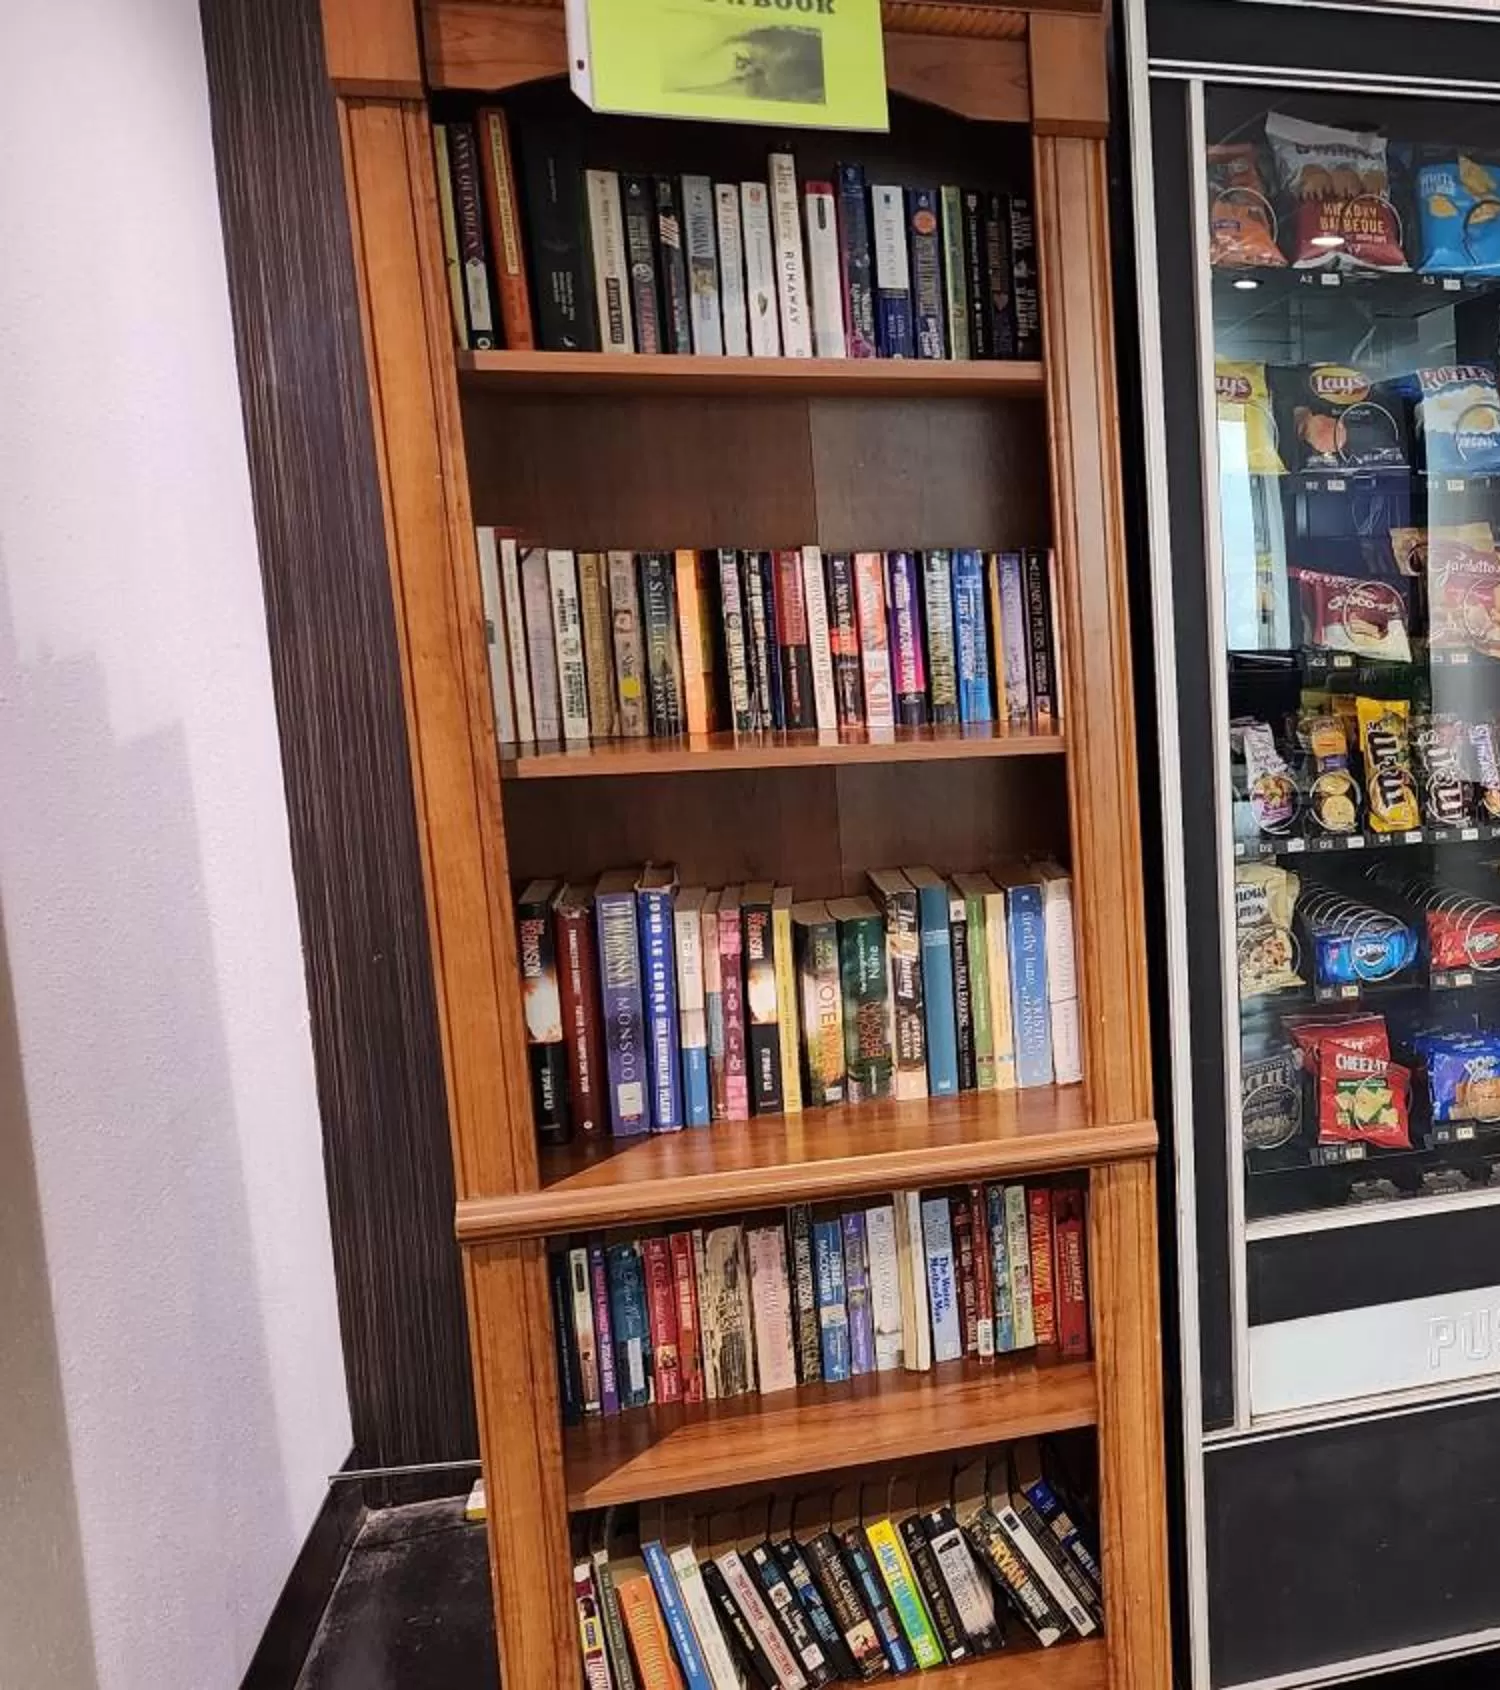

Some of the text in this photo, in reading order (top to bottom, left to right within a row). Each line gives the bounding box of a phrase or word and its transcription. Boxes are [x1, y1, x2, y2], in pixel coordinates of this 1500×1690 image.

[783, 250, 800, 325] RUNAWAY
[1316, 375, 1365, 395] Lay's
[1420, 366, 1496, 391] RUFFLES
[648, 579, 666, 616] Still
[519, 920, 541, 977] ROBINSON
[895, 948, 920, 1000] Young
[614, 997, 636, 1081] MONSOO
[870, 1000, 884, 1057] BROWN
[816, 1239, 832, 1301] MACOMBER
[929, 1257, 941, 1298] Method
[938, 1256, 948, 1274] The
[837, 1577, 864, 1624] GAIMAN
